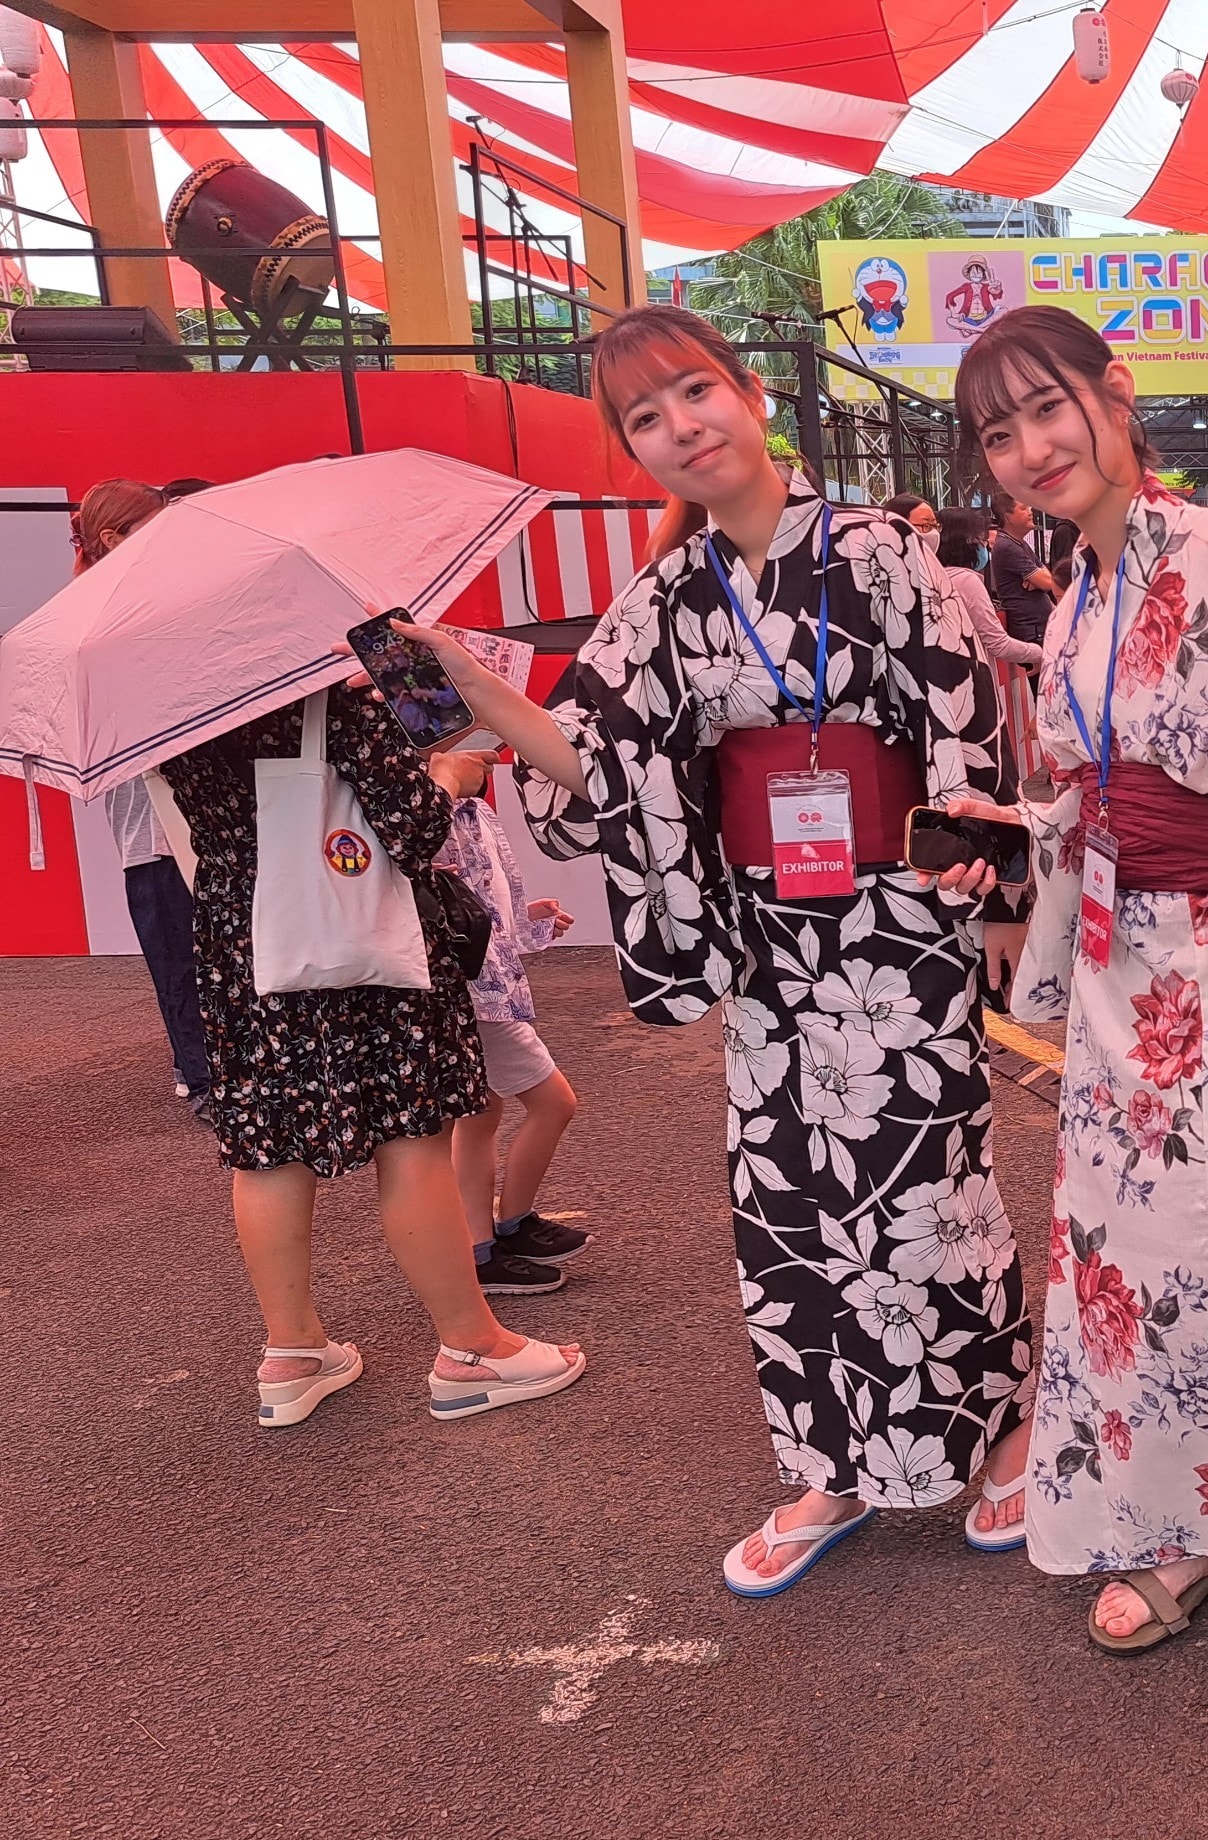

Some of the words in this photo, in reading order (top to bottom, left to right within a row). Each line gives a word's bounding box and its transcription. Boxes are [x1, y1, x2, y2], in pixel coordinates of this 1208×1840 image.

[1127, 352, 1171, 362] Vietnam
[782, 861, 844, 874] EXHIBITOR
[1082, 915, 1107, 941] EXHIBITOR
